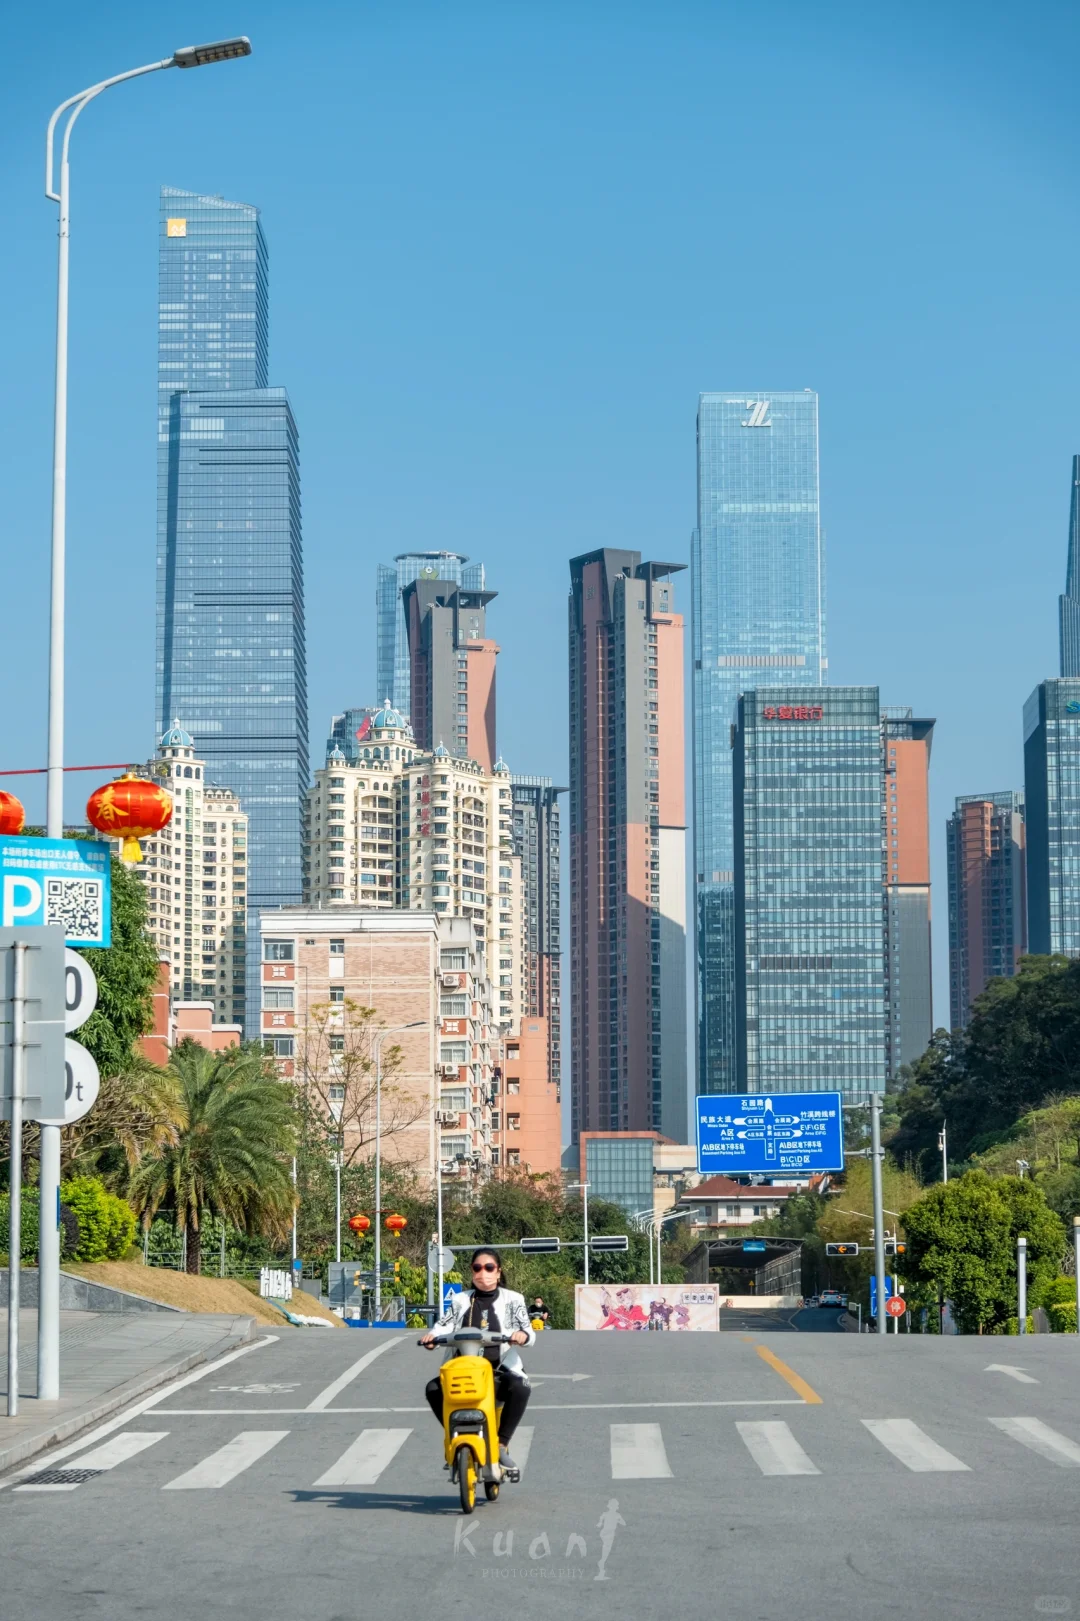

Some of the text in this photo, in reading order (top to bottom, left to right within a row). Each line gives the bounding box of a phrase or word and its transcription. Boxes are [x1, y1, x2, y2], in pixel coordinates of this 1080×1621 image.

[763, 705, 823, 720] 华夏银行
[97, 785, 129, 822] 春
[3, 875, 42, 926] P
[700, 1116, 732, 1124] 民族大道
[720, 1128, 734, 1137] A区
[890, 1301, 901, 1313] 停
